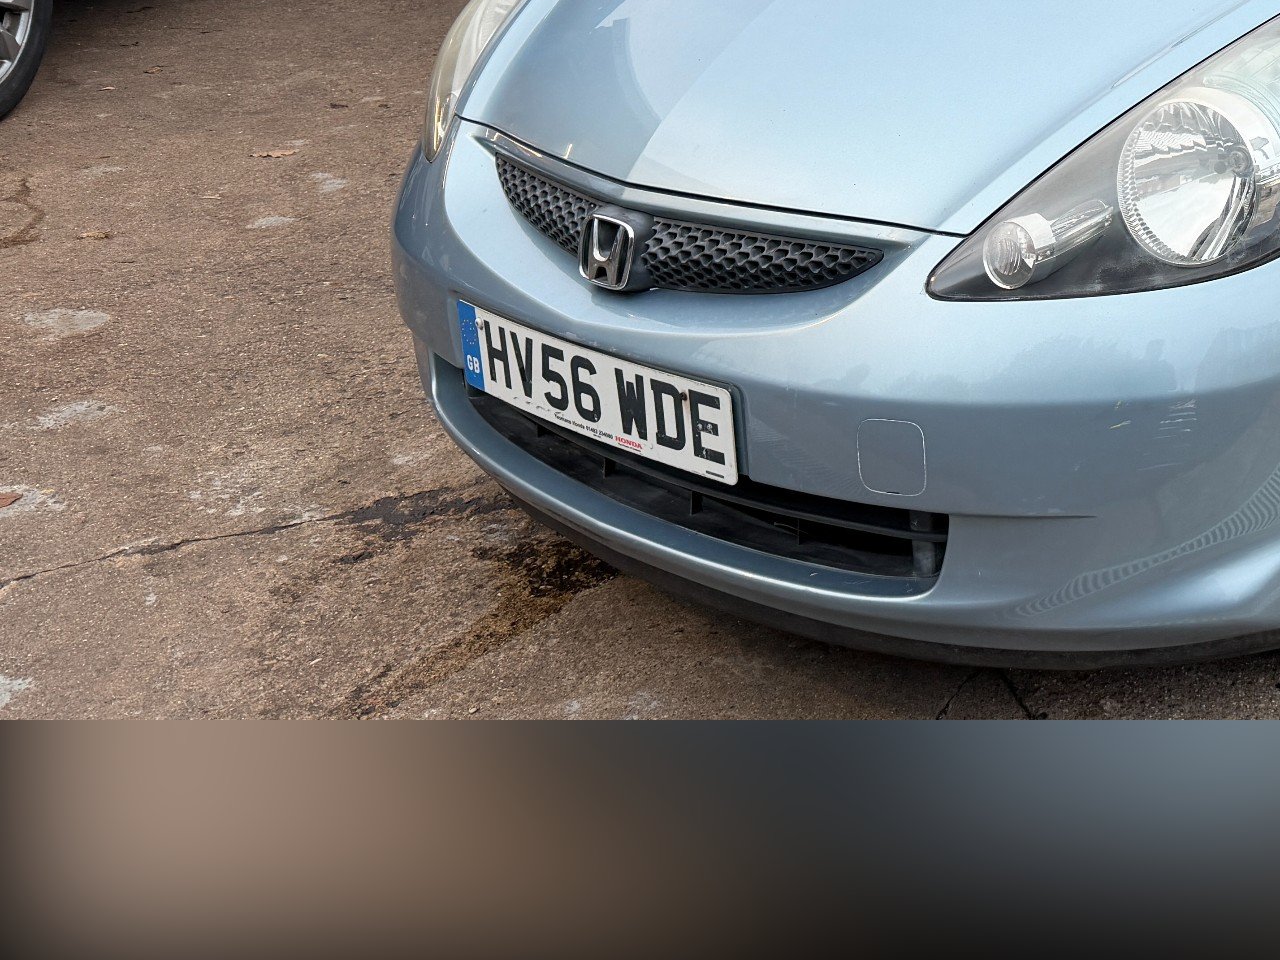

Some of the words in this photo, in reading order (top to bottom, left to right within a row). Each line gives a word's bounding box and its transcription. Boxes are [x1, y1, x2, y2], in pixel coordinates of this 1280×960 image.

[466, 354, 481, 375] GB
[483, 319, 602, 424] HV56
[614, 367, 726, 466] WDE
[615, 435, 643, 450] HONDA
